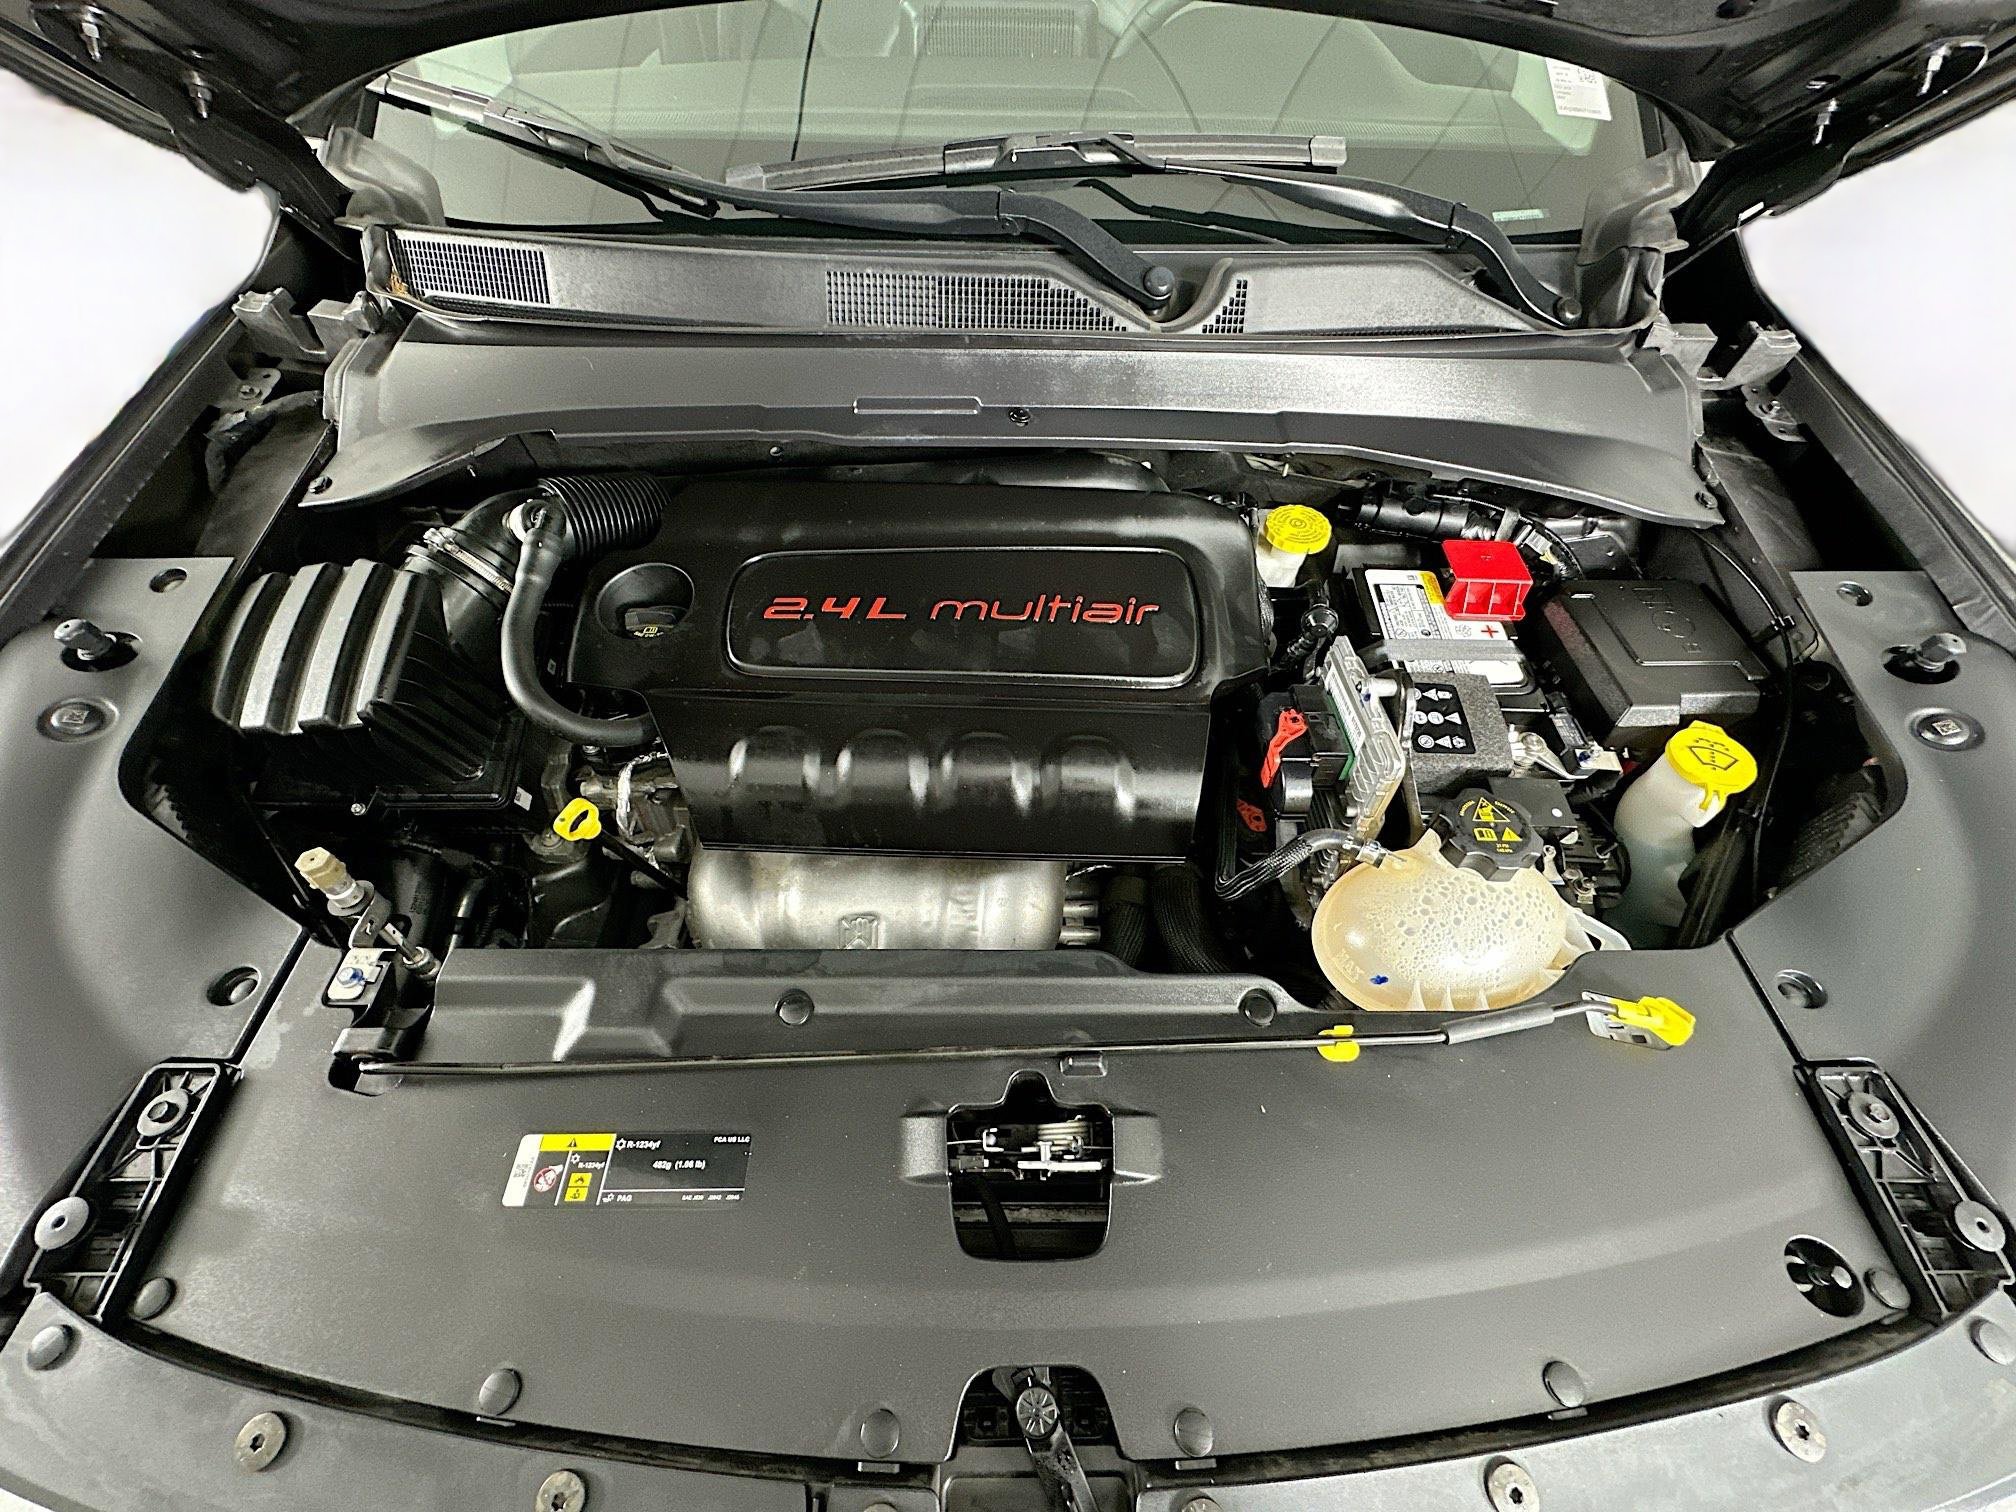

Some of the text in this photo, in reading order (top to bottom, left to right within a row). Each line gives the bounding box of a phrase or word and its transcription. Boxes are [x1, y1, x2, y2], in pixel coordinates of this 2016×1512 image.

[929, 594, 1161, 625] multiair
[626, 1139, 661, 1150] R-1234yf
[616, 1194, 633, 1202] PAG
